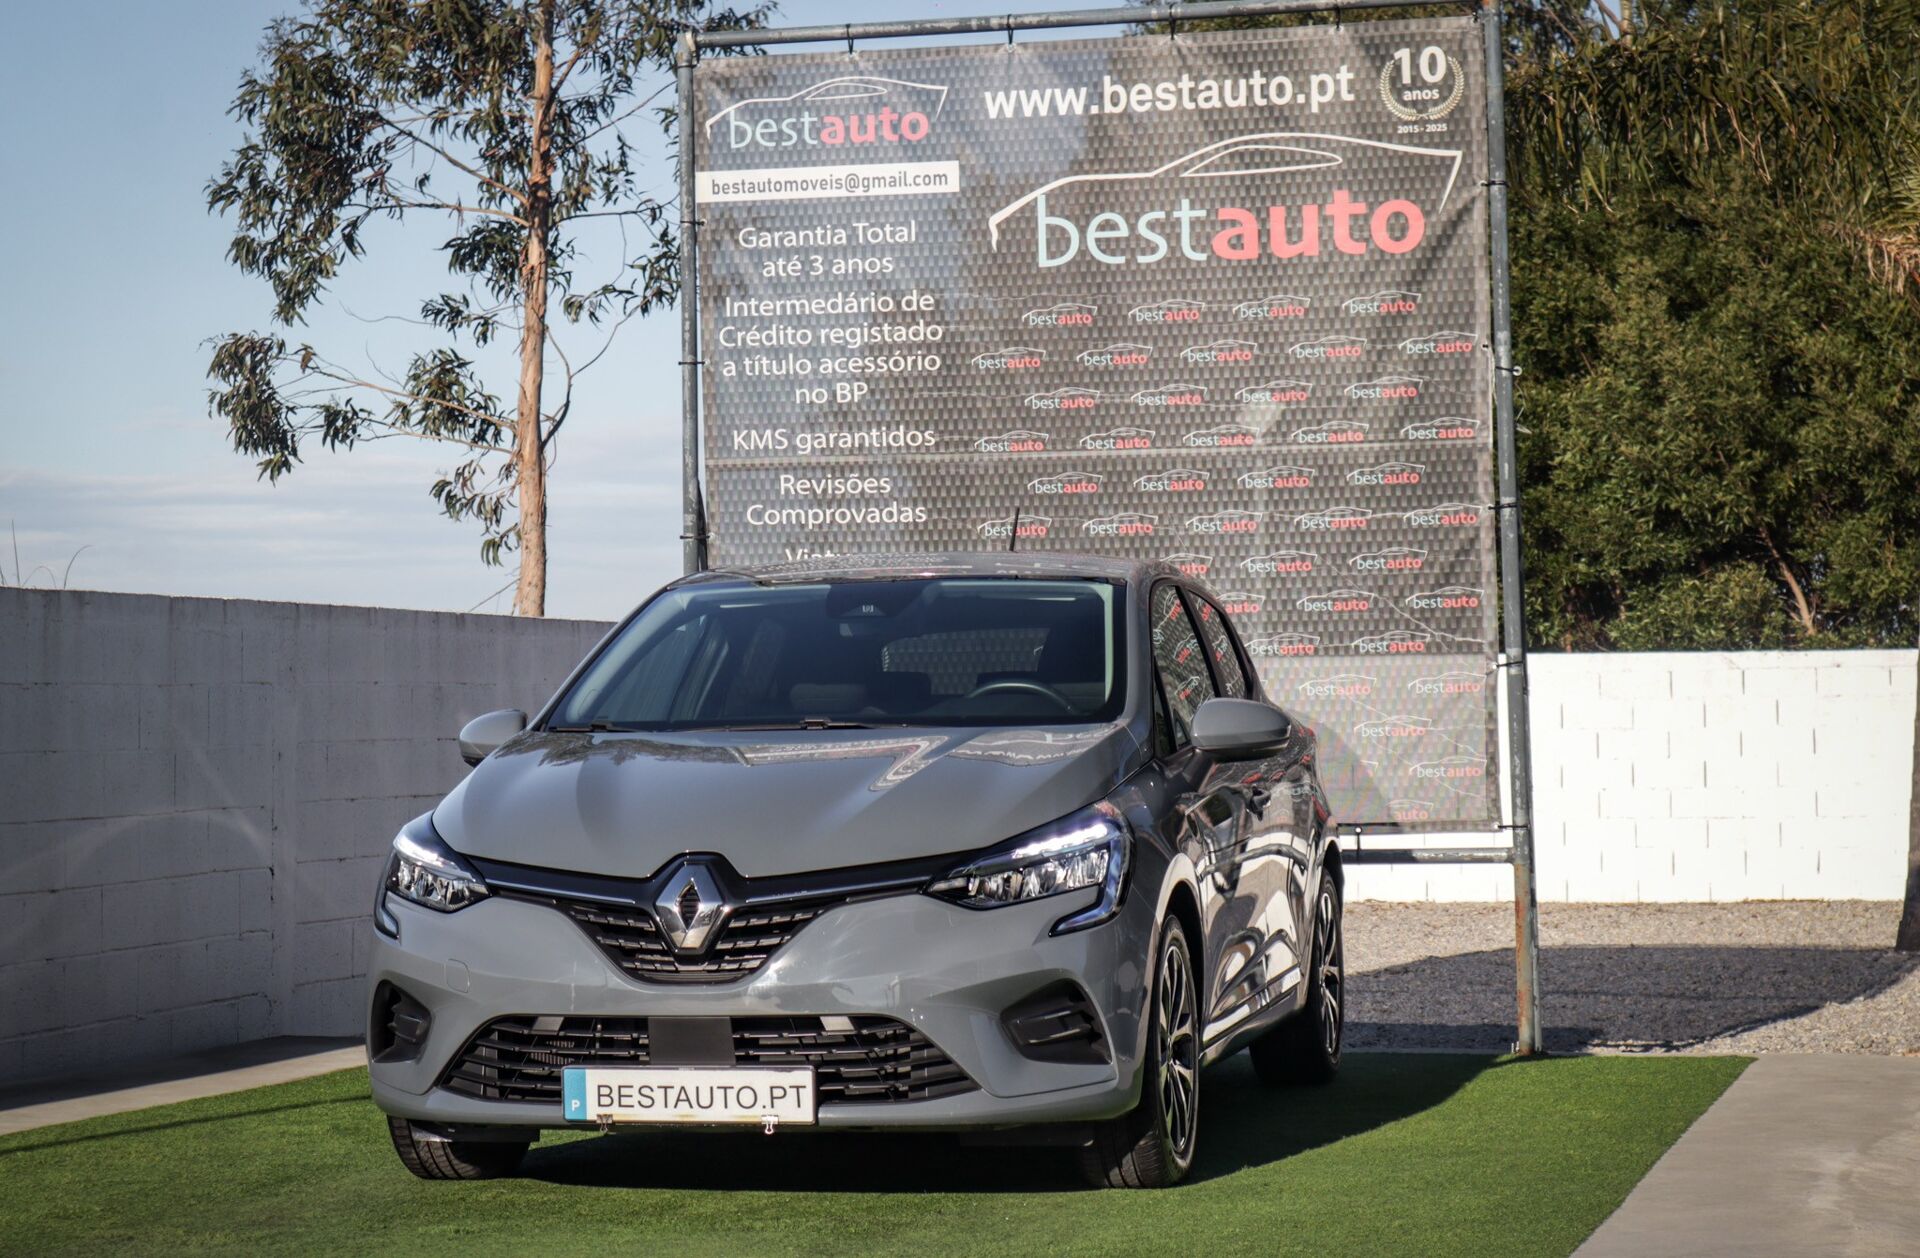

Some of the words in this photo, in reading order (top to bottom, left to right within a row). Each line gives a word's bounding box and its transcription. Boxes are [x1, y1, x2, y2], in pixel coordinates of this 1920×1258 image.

[1393, 45, 1447, 84] 10
[984, 65, 1355, 118] www.bestauto.pt
[1403, 89, 1440, 101] anos
[730, 106, 929, 149] bestauto
[1397, 124, 1419, 134] 2015
[1425, 123, 1447, 132] 2025
[711, 171, 948, 196] bestautomoveis@gmail.com
[738, 224, 847, 249] Garantia
[853, 220, 917, 244] Total
[1036, 189, 1426, 269] bestauto
[762, 255, 802, 278] até
[809, 255, 824, 276] 3
[832, 256, 894, 275] anos
[725, 291, 894, 318] Intermedário
[901, 289, 935, 312] de
[1350, 299, 1416, 314] bestauto
[1136, 309, 1199, 322] bestauto
[1240, 304, 1305, 318] bestauto
[1029, 313, 1092, 326] bestauto
[719, 323, 812, 348] Crédito
[820, 320, 943, 349] registado
[1296, 345, 1361, 359] bestauto
[1407, 340, 1472, 354] bestauto
[978, 356, 1041, 370] bestauto
[1084, 353, 1148, 366] bestauto
[1188, 349, 1252, 363] bestauto
[722, 363, 736, 377] a
[743, 353, 812, 377] título
[819, 351, 942, 375] acessório
[795, 388, 828, 404] no
[836, 382, 868, 403] BP
[1138, 392, 1201, 406] bestauto
[1242, 389, 1308, 403] bestauto
[1352, 385, 1418, 399] bestauto
[1032, 396, 1094, 410] bestauto
[1298, 429, 1364, 443] bestauto
[1408, 425, 1474, 440] bestauto
[733, 429, 789, 450] KMS
[796, 425, 936, 455] garantidos
[982, 438, 1044, 452] bestauto
[1087, 436, 1150, 450] bestauto
[1190, 433, 1254, 447] bestauto
[779, 473, 891, 495] Revisões
[1245, 474, 1310, 489] bestauto
[1354, 470, 1420, 485] bestauto
[1035, 480, 1098, 495] bestauto
[1141, 478, 1204, 492] bestauto
[747, 502, 927, 529] Comprovadas
[1302, 515, 1367, 529] bestauto
[1411, 511, 1477, 526] bestauto
[1090, 520, 1153, 534] bestauto
[1193, 518, 1257, 532] bestauto
[1247, 560, 1312, 573] bestauto
[1357, 556, 1422, 570] bestauto
[1304, 598, 1368, 612] bestauto
[1413, 595, 1478, 609] bestauto
[1250, 642, 1315, 656] bestauto
[1359, 638, 1424, 653] bestauto
[1306, 683, 1371, 697] bestauto
[1415, 681, 1481, 695] bestauto
[1361, 724, 1426, 738] bestauto
[1417, 765, 1482, 779] bestauto
[597, 1084, 807, 1110] BESTAUTO.PT
[571, 1099, 580, 1111] P
